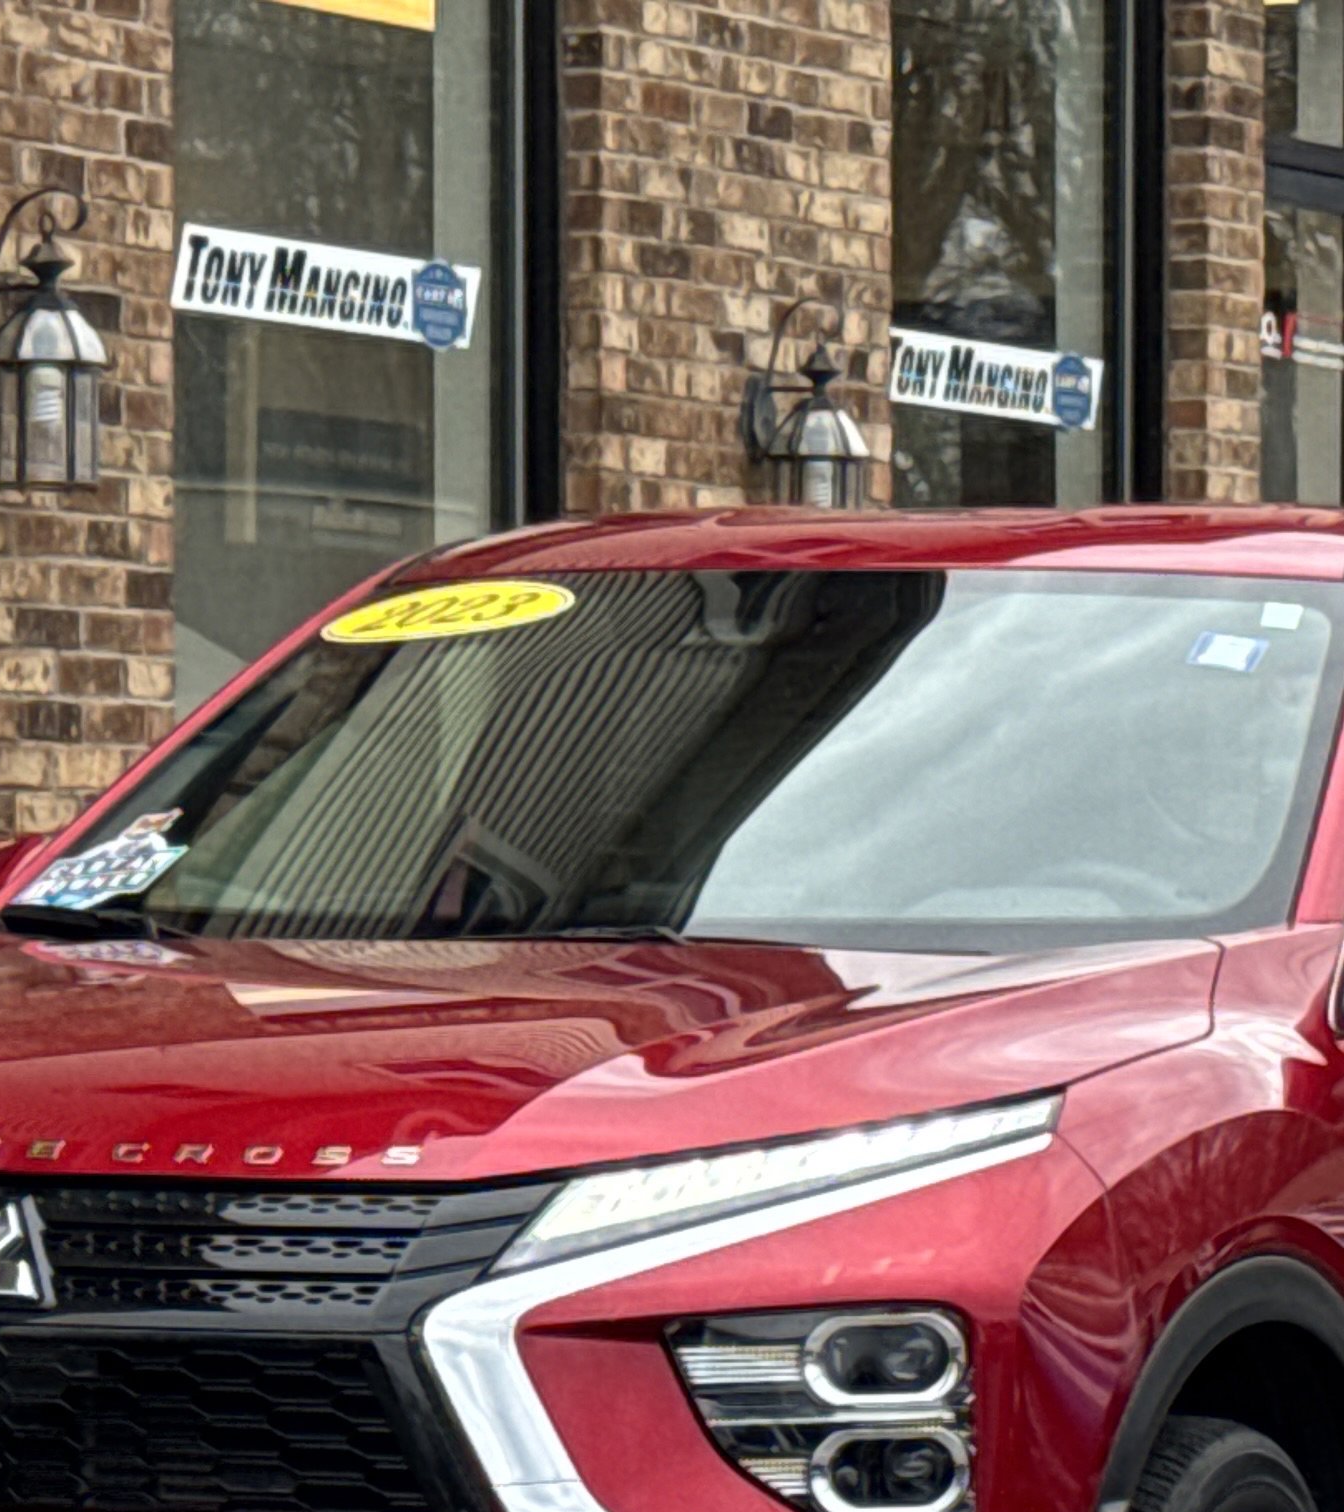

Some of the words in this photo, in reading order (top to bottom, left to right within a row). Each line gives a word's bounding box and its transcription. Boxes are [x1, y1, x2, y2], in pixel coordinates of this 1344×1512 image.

[181, 233, 268, 310] TONY
[350, 592, 541, 634] 2023
[111, 1142, 423, 1166] CROSS
